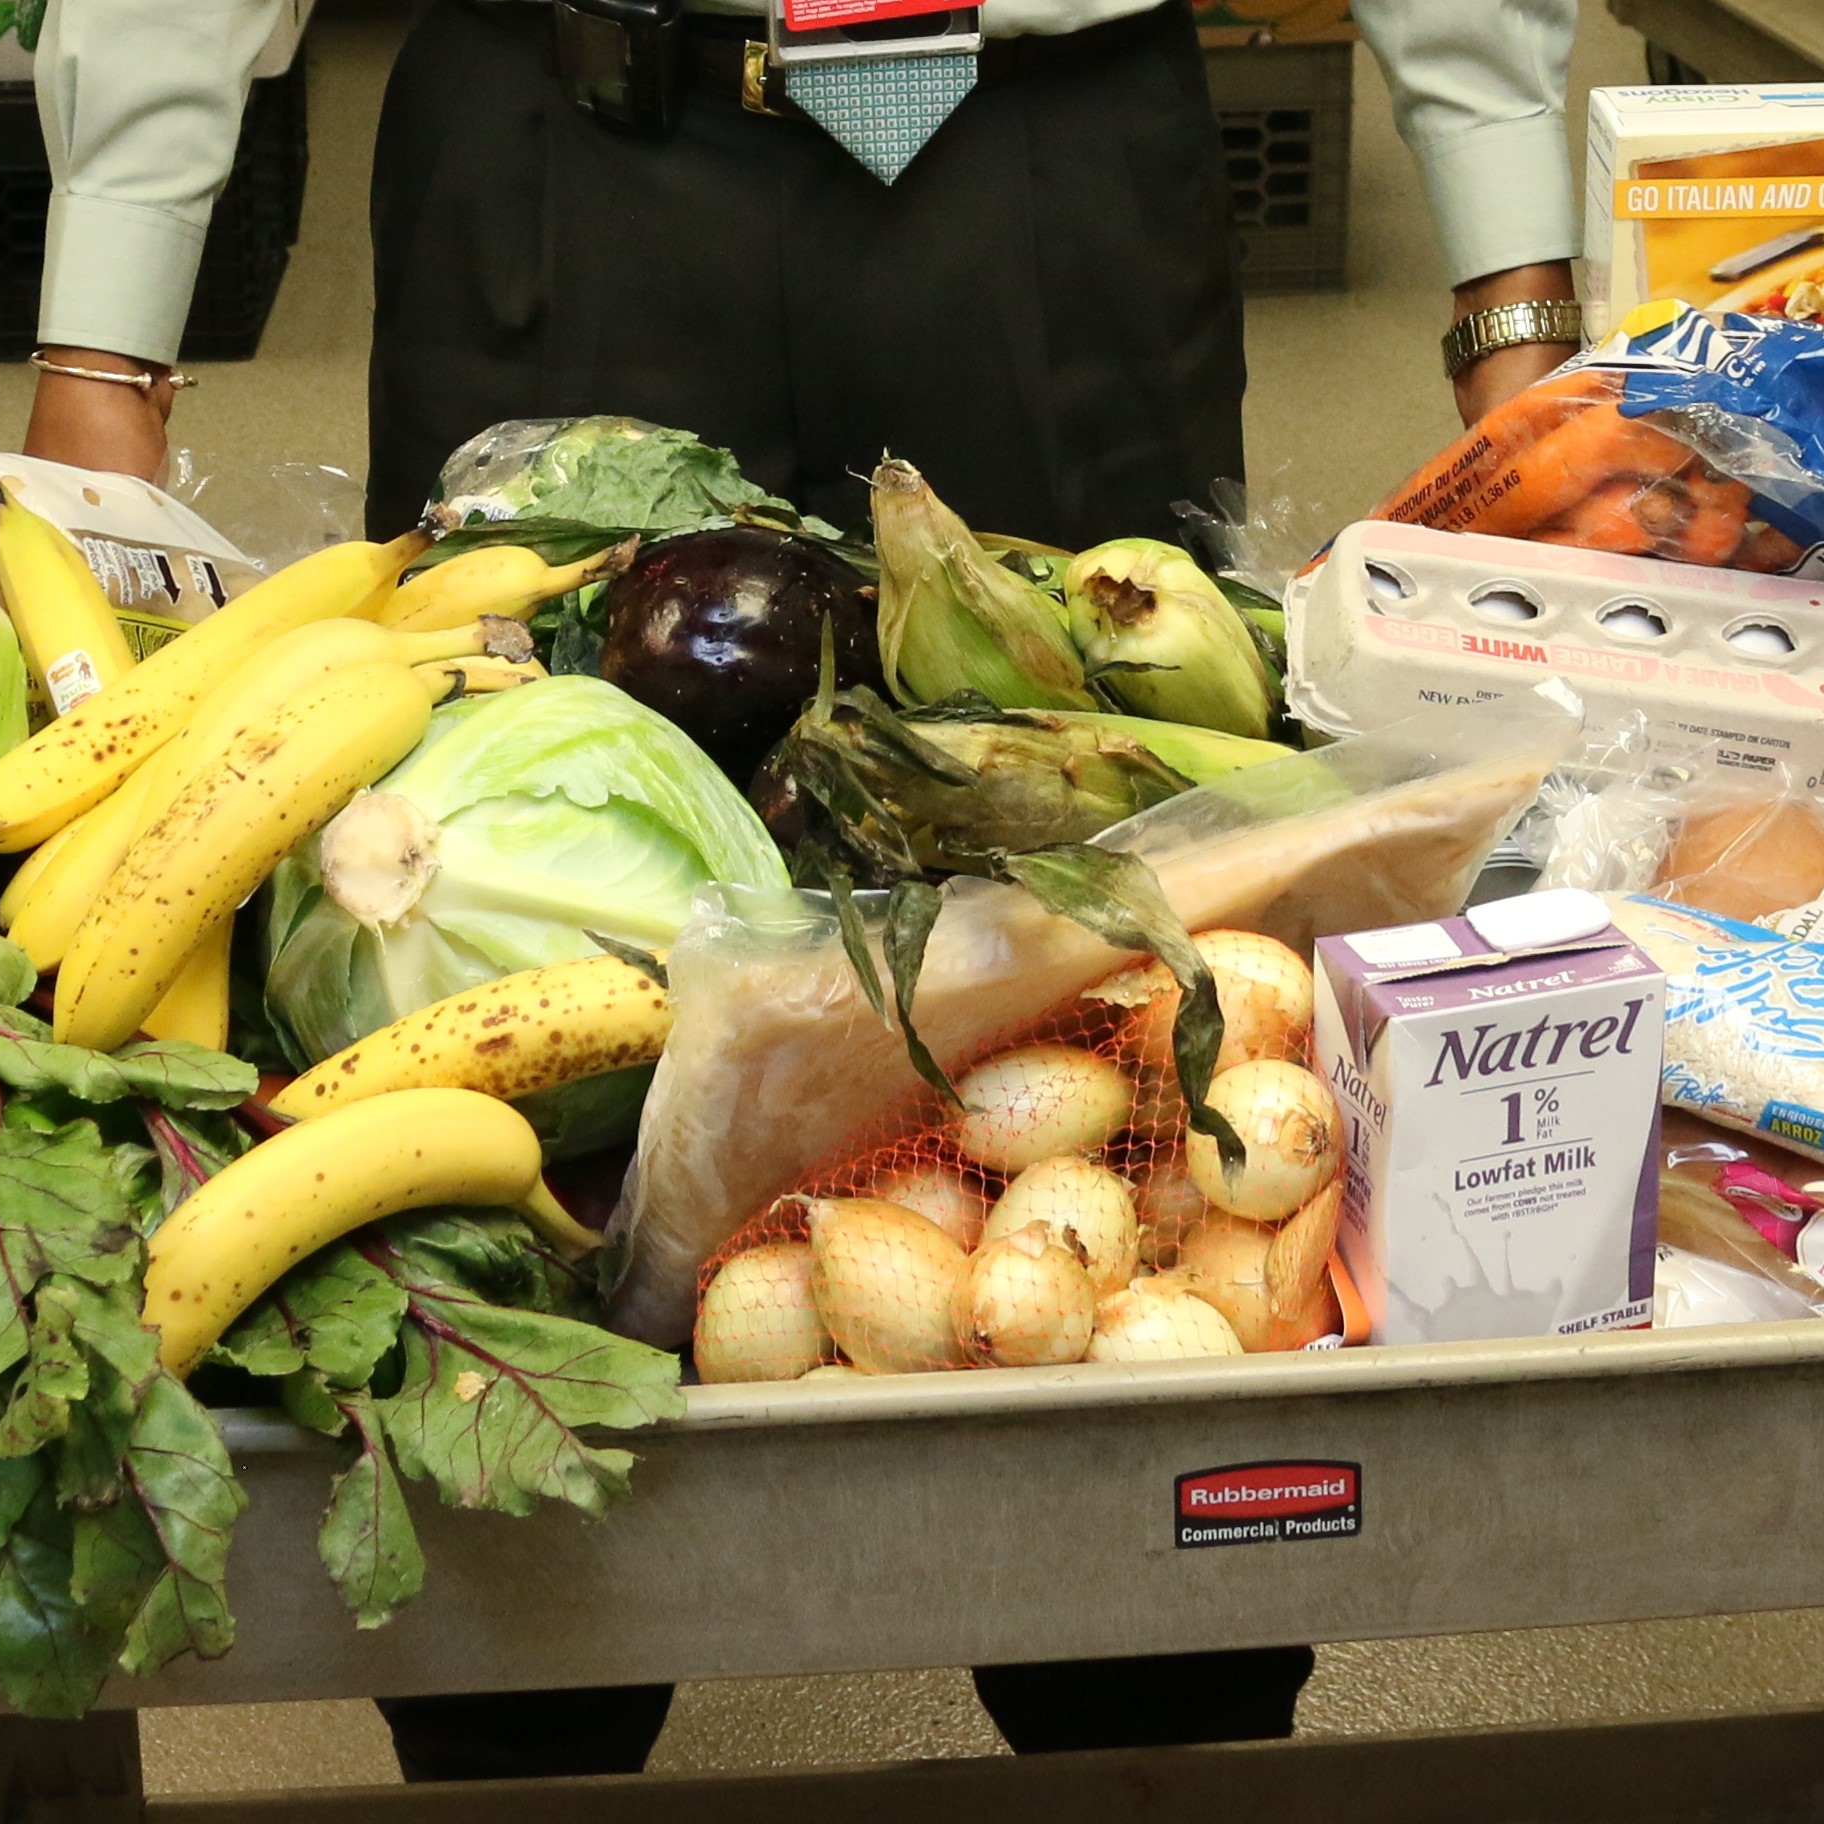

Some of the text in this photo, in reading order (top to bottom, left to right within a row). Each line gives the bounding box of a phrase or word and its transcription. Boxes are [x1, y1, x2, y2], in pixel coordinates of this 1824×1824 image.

[1618, 87, 1750, 100] Hexagons
[1646, 93, 1741, 107] Crispy
[1627, 185, 1659, 213] GO
[1667, 181, 1755, 212] ITALIAN
[1760, 180, 1813, 210] AND
[1388, 435, 1493, 522] PRODUIT DU CANADA
[1458, 505, 1476, 525] LB
[1480, 482, 1504, 508] 1.36
[1503, 469, 1521, 491] KG
[1460, 633, 1549, 664] WHITE
[1418, 688, 1454, 707] NEW
[1806, 776, 1819, 791] 0
[1791, 907, 1824, 942] DAL
[1467, 970, 1574, 1001] Natrel
[1423, 998, 1644, 1089] Natrel
[1331, 1053, 1387, 1134] Natrel
[1536, 1116, 1561, 1129] Milk
[1536, 1128, 1553, 1140] Fat
[1769, 1117, 1824, 1147] ARROZ
[1454, 1145, 1597, 1192] Lowfat Milk
[1464, 1187, 1587, 1218] comes from not treated
[1467, 1177, 1584, 1208] Our farmers pledge this milk
[1491, 1210, 1510, 1223] with
[1558, 1302, 1648, 1336] SHELF STABLE
[1190, 1478, 1346, 1506] Rubbermaid
[1181, 1516, 1356, 1543] Commercial Products
